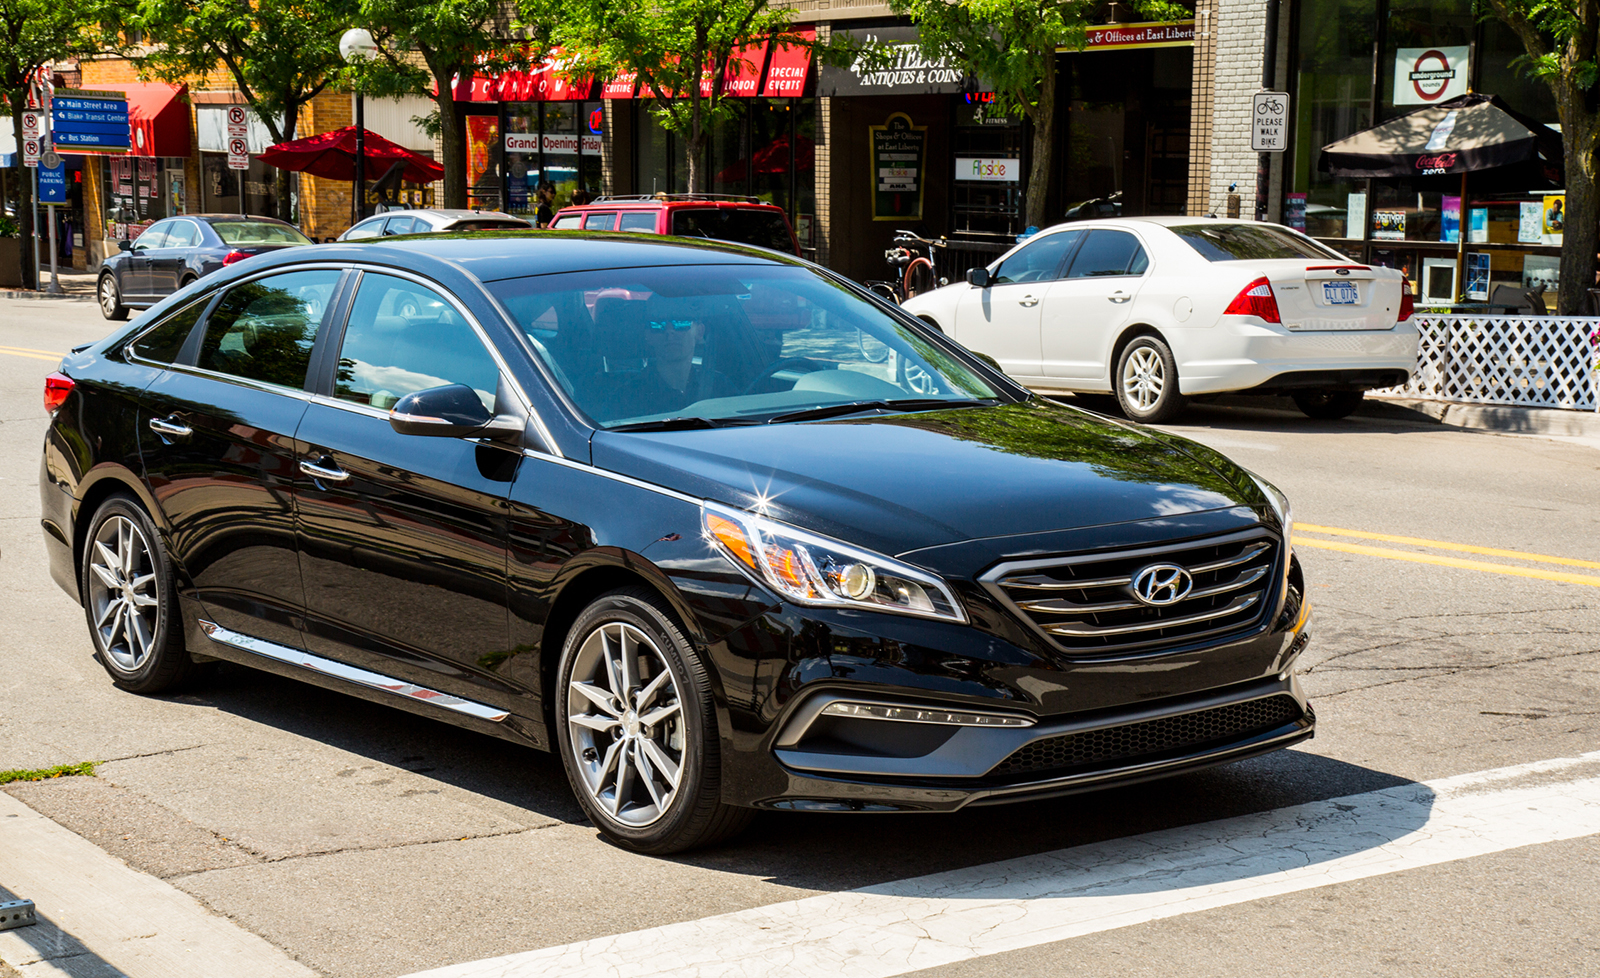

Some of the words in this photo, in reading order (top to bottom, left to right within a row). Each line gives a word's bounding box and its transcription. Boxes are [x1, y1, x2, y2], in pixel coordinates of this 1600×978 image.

[1105, 31, 1134, 43] Offices
[1146, 29, 1164, 40] East
[1166, 27, 1195, 40] Liberty
[770, 67, 804, 77] SPECIAL
[1411, 70, 1453, 80] underground
[860, 71, 916, 87] ANTIQUES
[916, 70, 926, 84] &
[928, 69, 964, 83] COINS
[605, 84, 632, 93] CUISINE
[724, 80, 755, 91] LIQUOR
[769, 80, 801, 90] EVENTS
[67, 112, 84, 120] Blake
[85, 113, 105, 121] Transit
[107, 114, 126, 122] Center
[1256, 118, 1283, 126] PLEASE
[506, 136, 538, 149] Grand
[543, 136, 579, 152] Opening
[581, 137, 601, 153] Friday
[885, 142, 897, 150] East
[1261, 138, 1277, 146] BIKE
[1415, 152, 1457, 169] Coca-Cola
[1325, 288, 1338, 299] CLT
[1341, 288, 1358, 299] 0776
[660, 631, 684, 675] KUMHO
